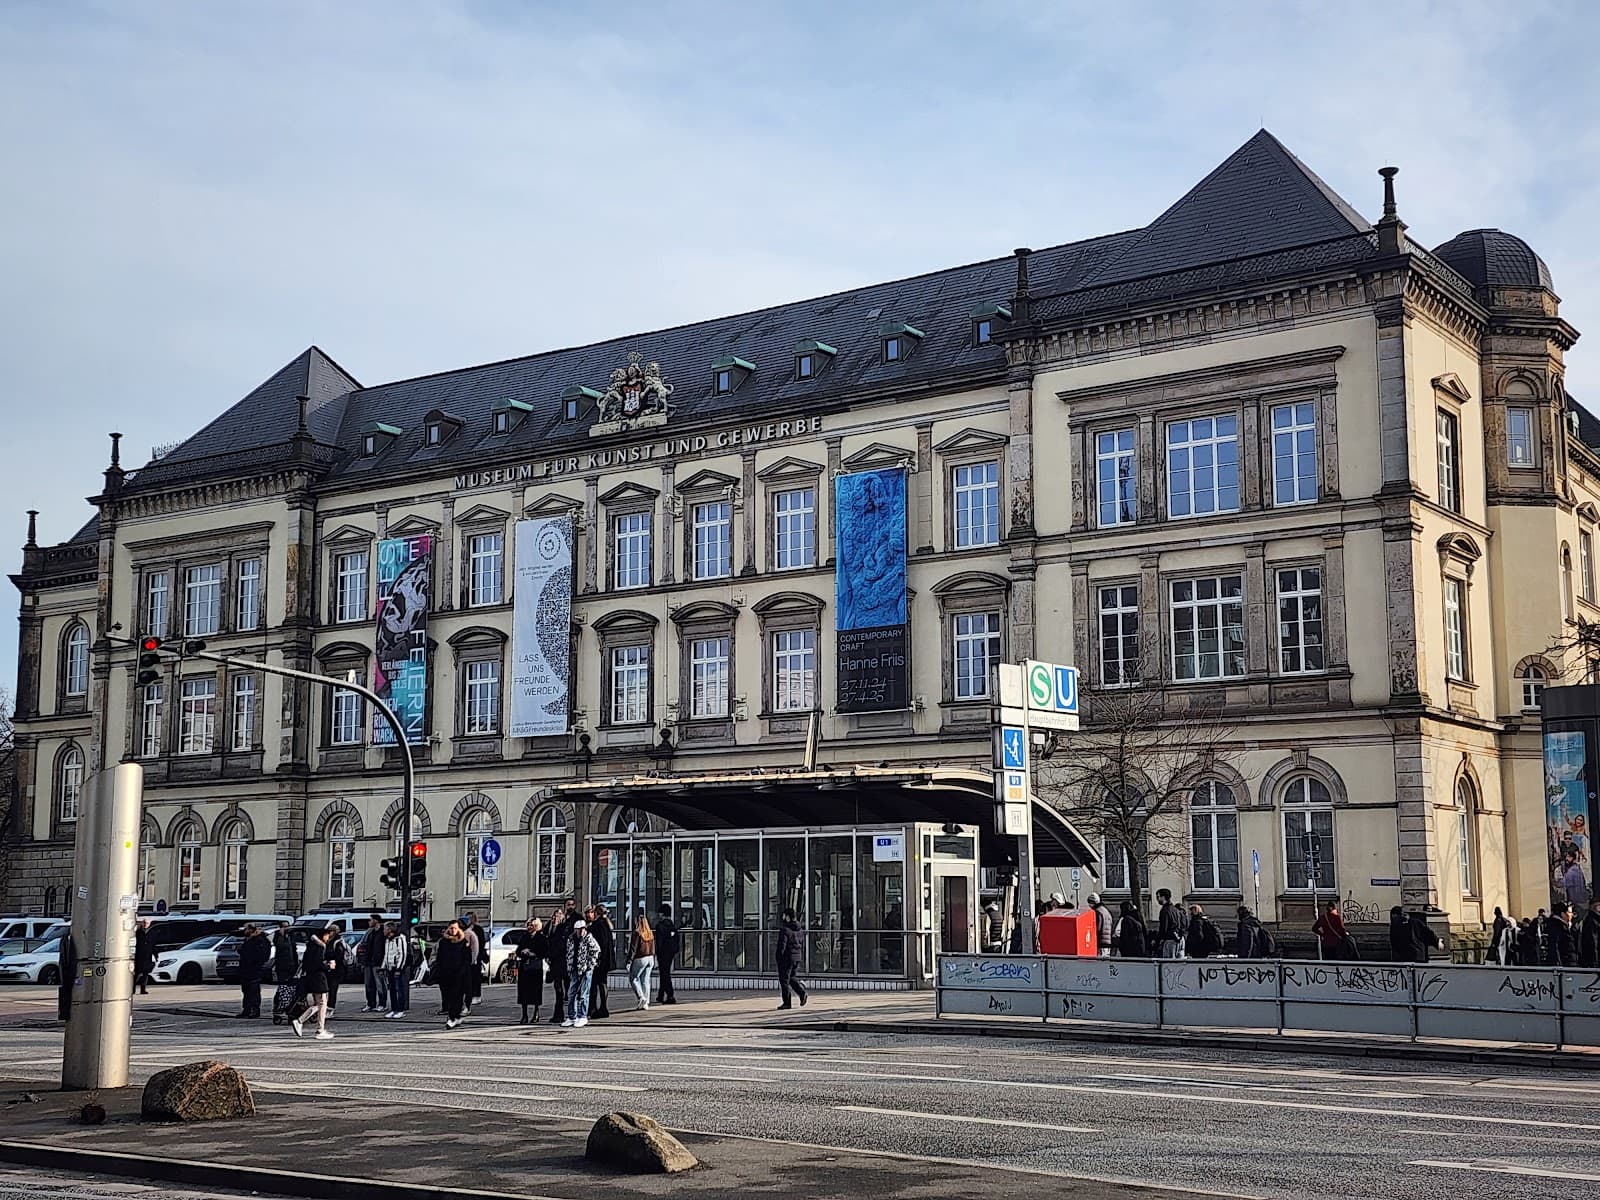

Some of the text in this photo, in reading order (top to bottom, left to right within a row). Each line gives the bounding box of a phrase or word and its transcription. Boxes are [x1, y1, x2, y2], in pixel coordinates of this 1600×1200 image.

[454, 416, 822, 489] MUSEUM FÜR KUNST UND GEWERBE
[840, 630, 903, 643] CONTEMPORARY
[840, 642, 865, 652] CRAFT
[519, 654, 539, 663] LASS
[840, 653, 905, 671] Hanne Friis
[528, 665, 545, 674] UNS
[407, 629, 425, 742] FEIERN!
[514, 675, 551, 685] FREUNDE
[1032, 668, 1049, 704] S
[524, 686, 560, 697] WERDEN
[1057, 669, 1075, 707] U
[840, 690, 885, 704] 27.4.25
[1198, 966, 1218, 989] NO
[1304, 967, 1328, 986] NO
